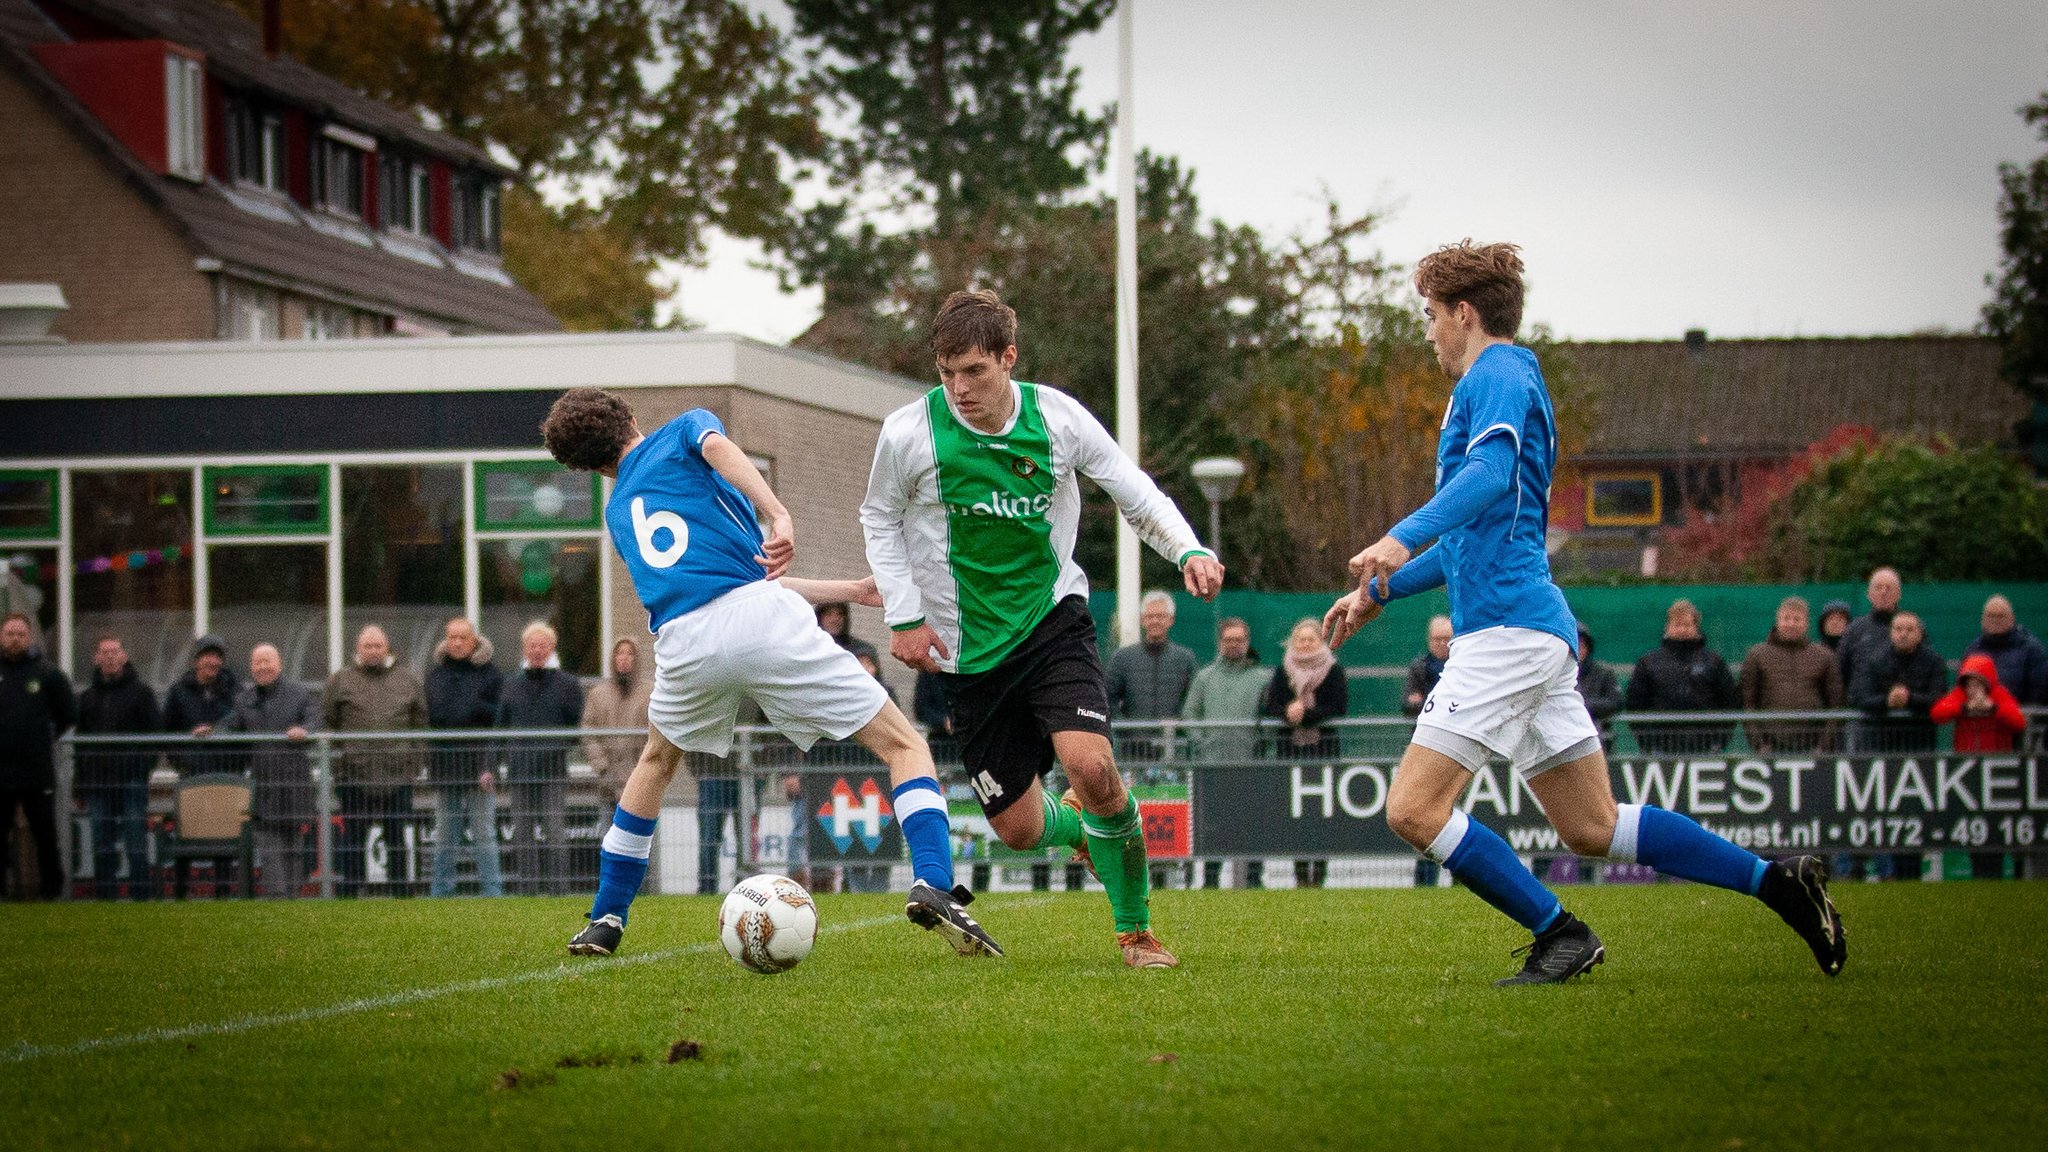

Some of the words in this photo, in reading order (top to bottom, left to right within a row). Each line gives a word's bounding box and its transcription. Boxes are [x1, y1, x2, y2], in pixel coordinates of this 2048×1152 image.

[631, 497, 689, 569] 6
[1424, 694, 1435, 713] 6
[971, 769, 1004, 805] 14
[1291, 764, 1548, 818] HOAN
[1622, 760, 1815, 813] WEST
[1835, 758, 2048, 813] MAKEL
[1849, 816, 1924, 847] 0172
[1951, 816, 1990, 847] 49
[1999, 816, 2036, 847] 16
